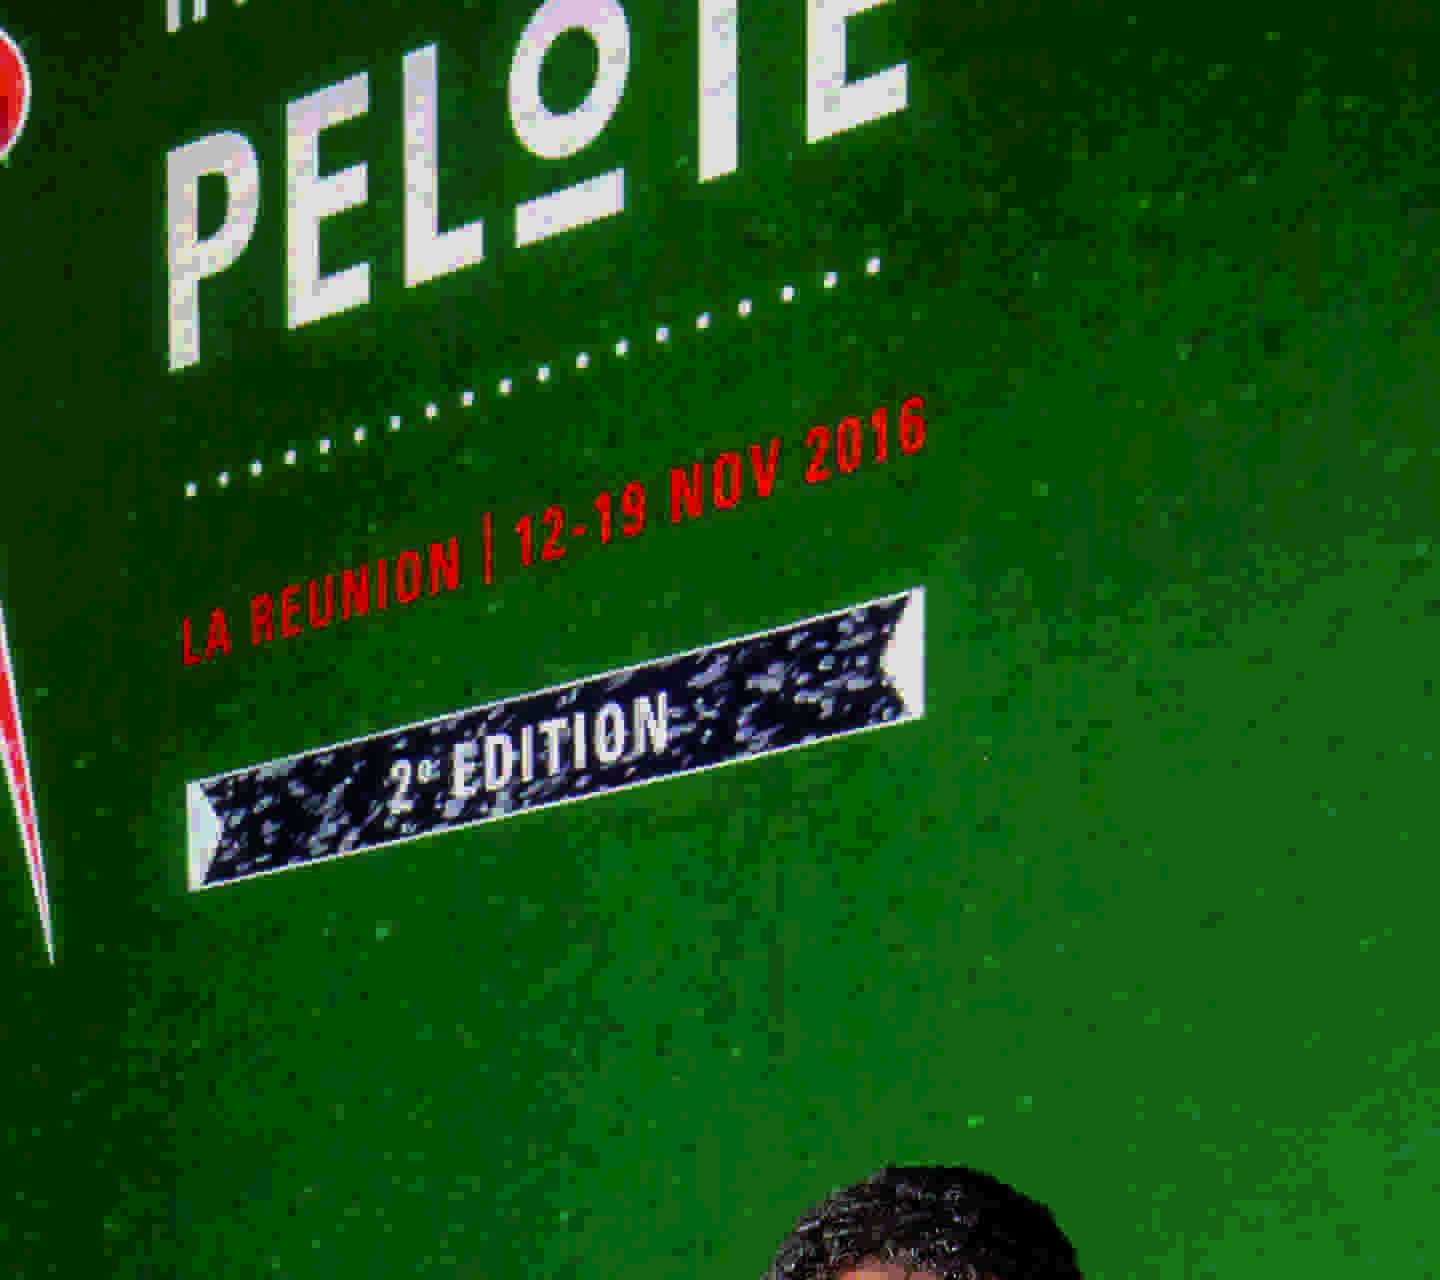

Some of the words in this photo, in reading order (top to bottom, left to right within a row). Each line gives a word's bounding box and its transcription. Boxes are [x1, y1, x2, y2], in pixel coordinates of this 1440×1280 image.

[182, 607, 232, 666] LA
[515, 481, 647, 568] 12-19
[670, 439, 782, 525] NOV
[805, 396, 927, 484] 2016
